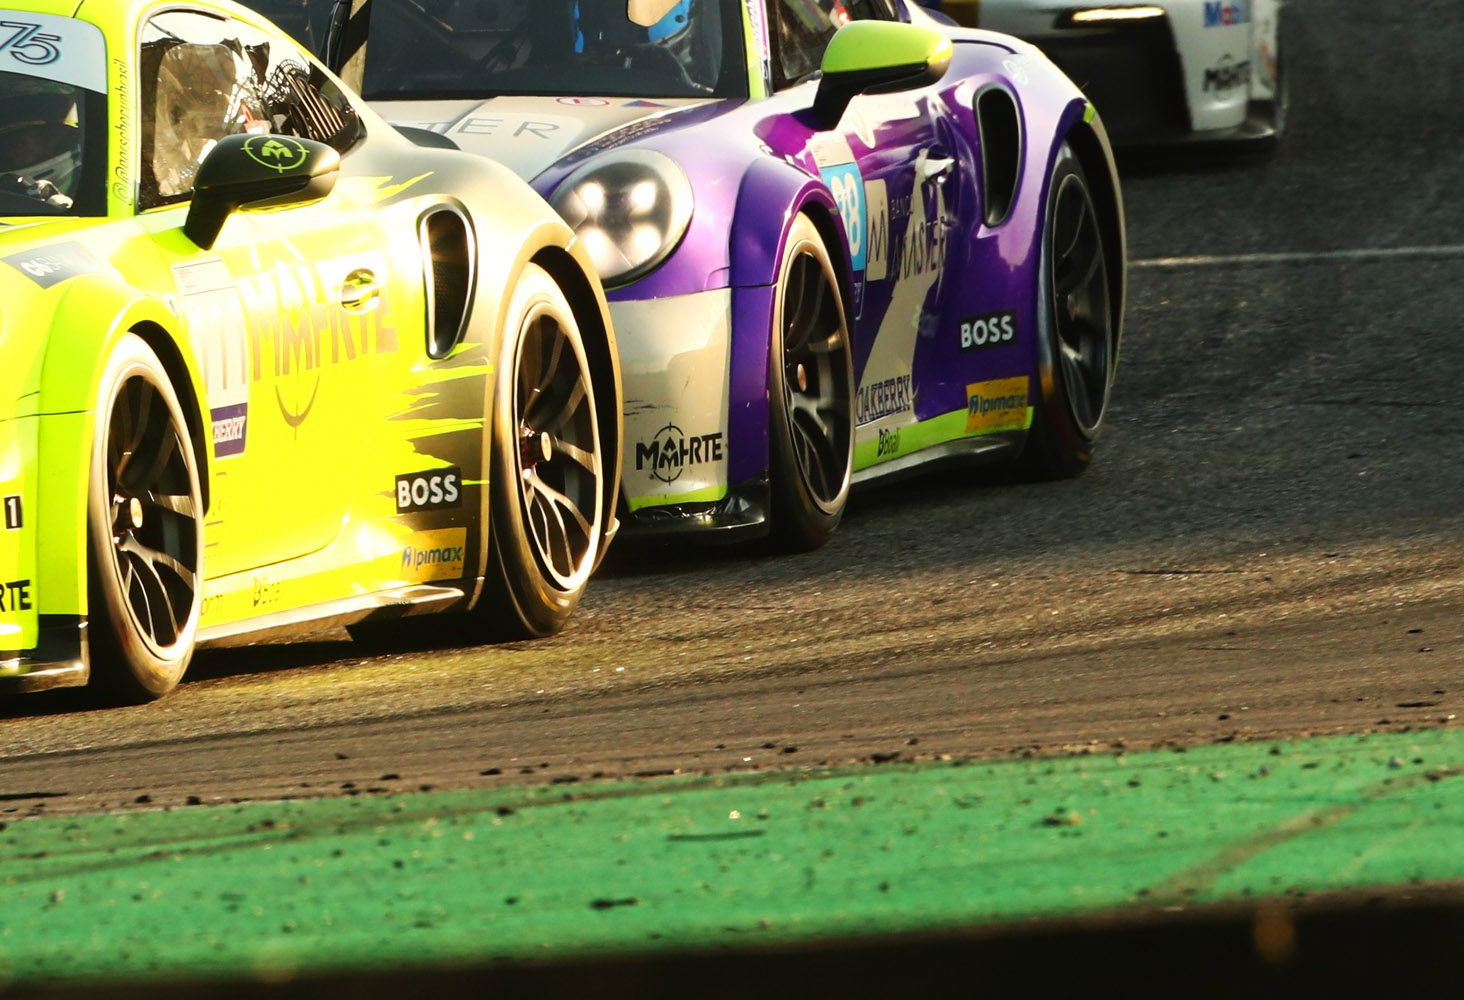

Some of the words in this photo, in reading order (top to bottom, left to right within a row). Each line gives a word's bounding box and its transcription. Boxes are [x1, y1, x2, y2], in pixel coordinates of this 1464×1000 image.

[960, 314, 1014, 349] BOSS
[856, 374, 911, 424] OAKBERRY
[397, 474, 459, 508] BOSS
